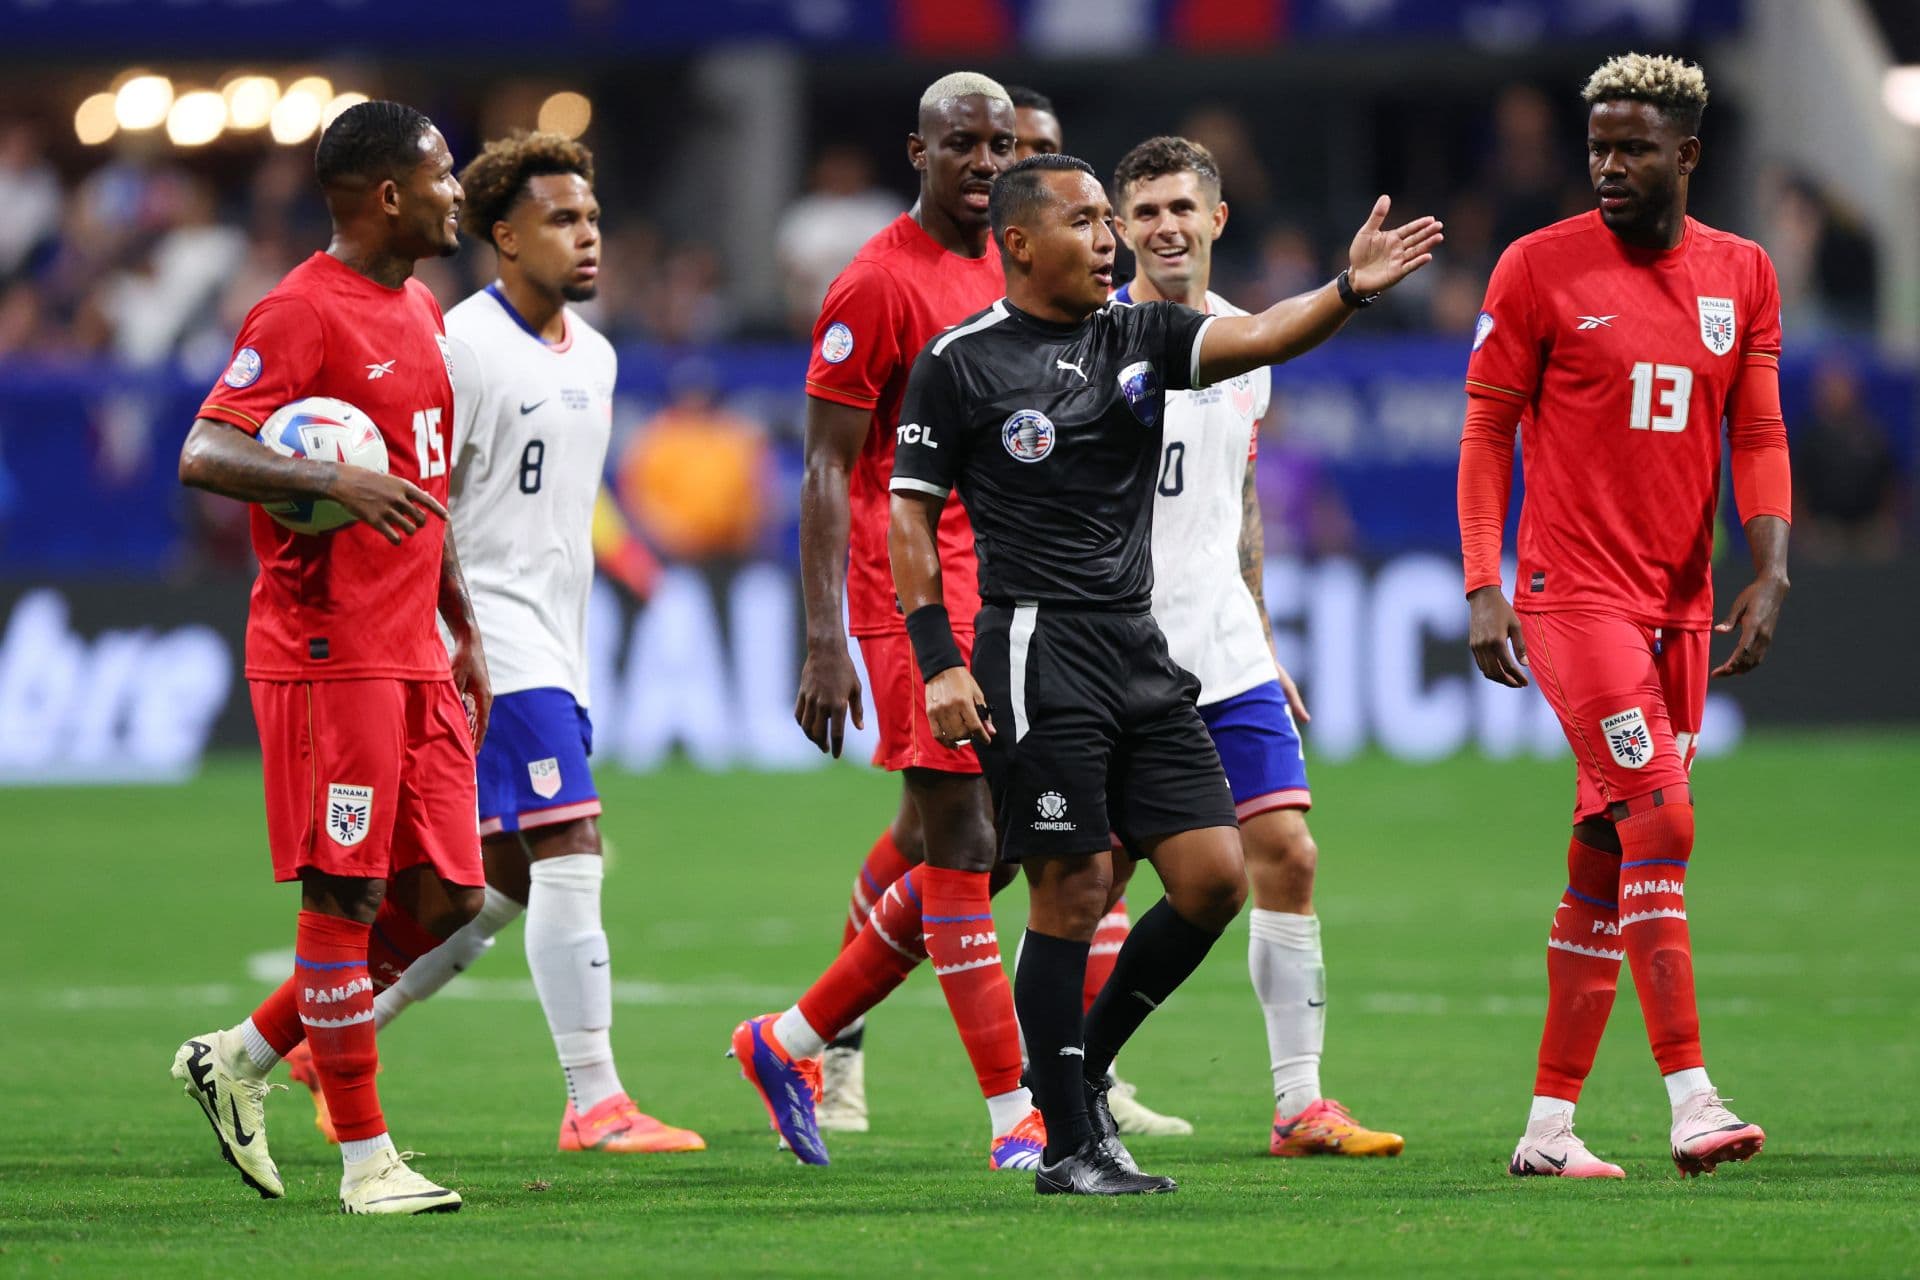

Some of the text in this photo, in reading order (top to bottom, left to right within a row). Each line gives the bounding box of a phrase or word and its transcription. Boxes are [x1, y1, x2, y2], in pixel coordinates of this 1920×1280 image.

[1701, 300, 1731, 309] PANAMA
[1629, 361, 1694, 432] 13
[411, 407, 446, 480] 15
[896, 423, 938, 449] TCL
[519, 440, 545, 494] 8
[1604, 711, 1639, 729] PANAMA
[333, 788, 368, 797] PANAMA
